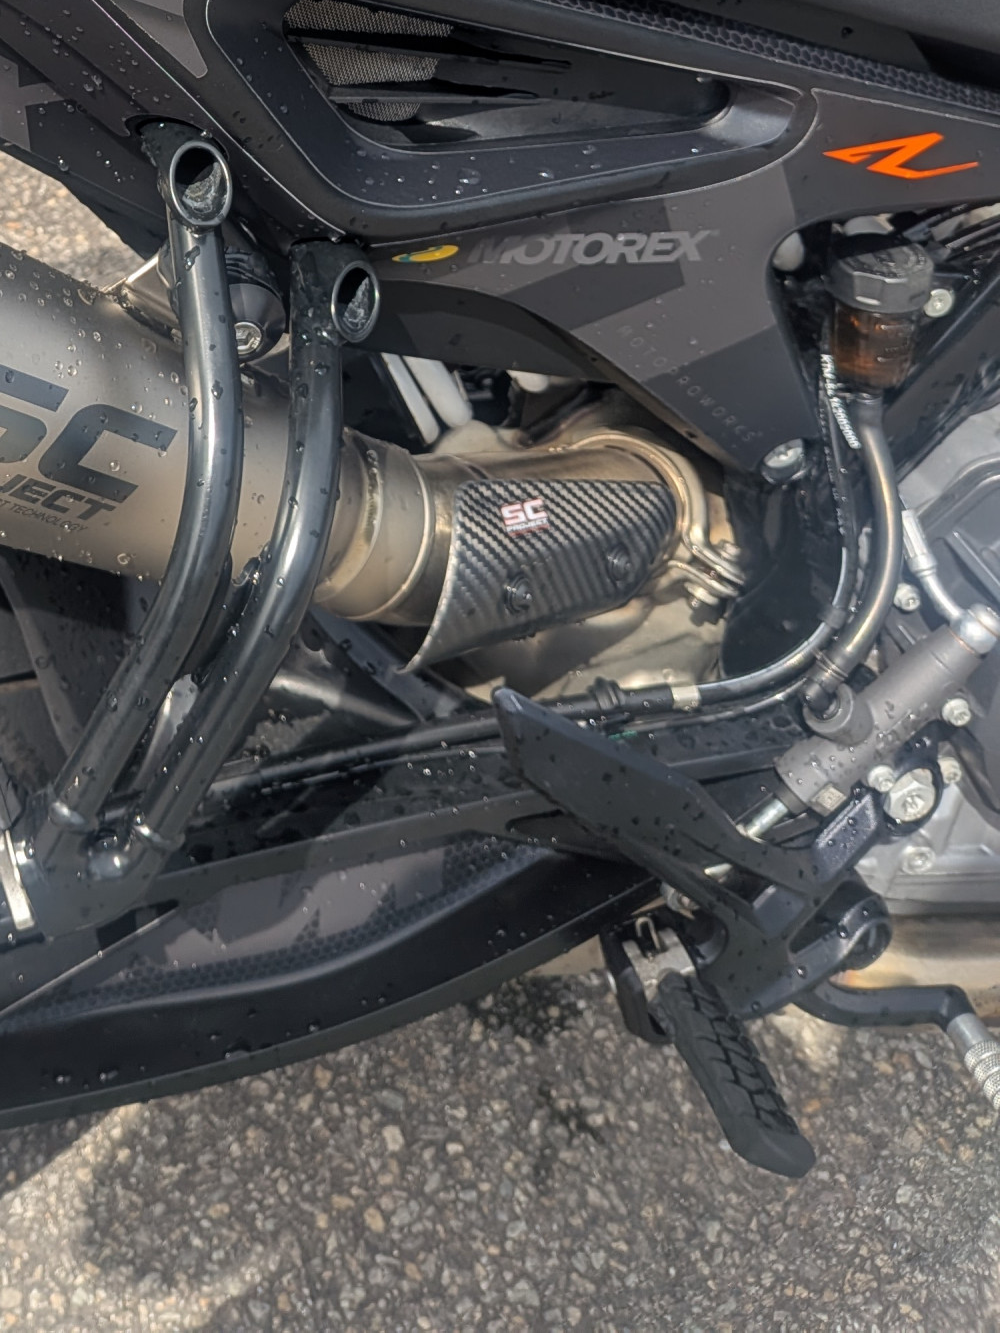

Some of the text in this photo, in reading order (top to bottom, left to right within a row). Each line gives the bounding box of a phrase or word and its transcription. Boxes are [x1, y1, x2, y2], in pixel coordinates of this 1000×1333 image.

[467, 230, 713, 265] MOTOREX
[10, 502, 89, 532] TECHNOLOGY
[501, 498, 548, 525] SC
